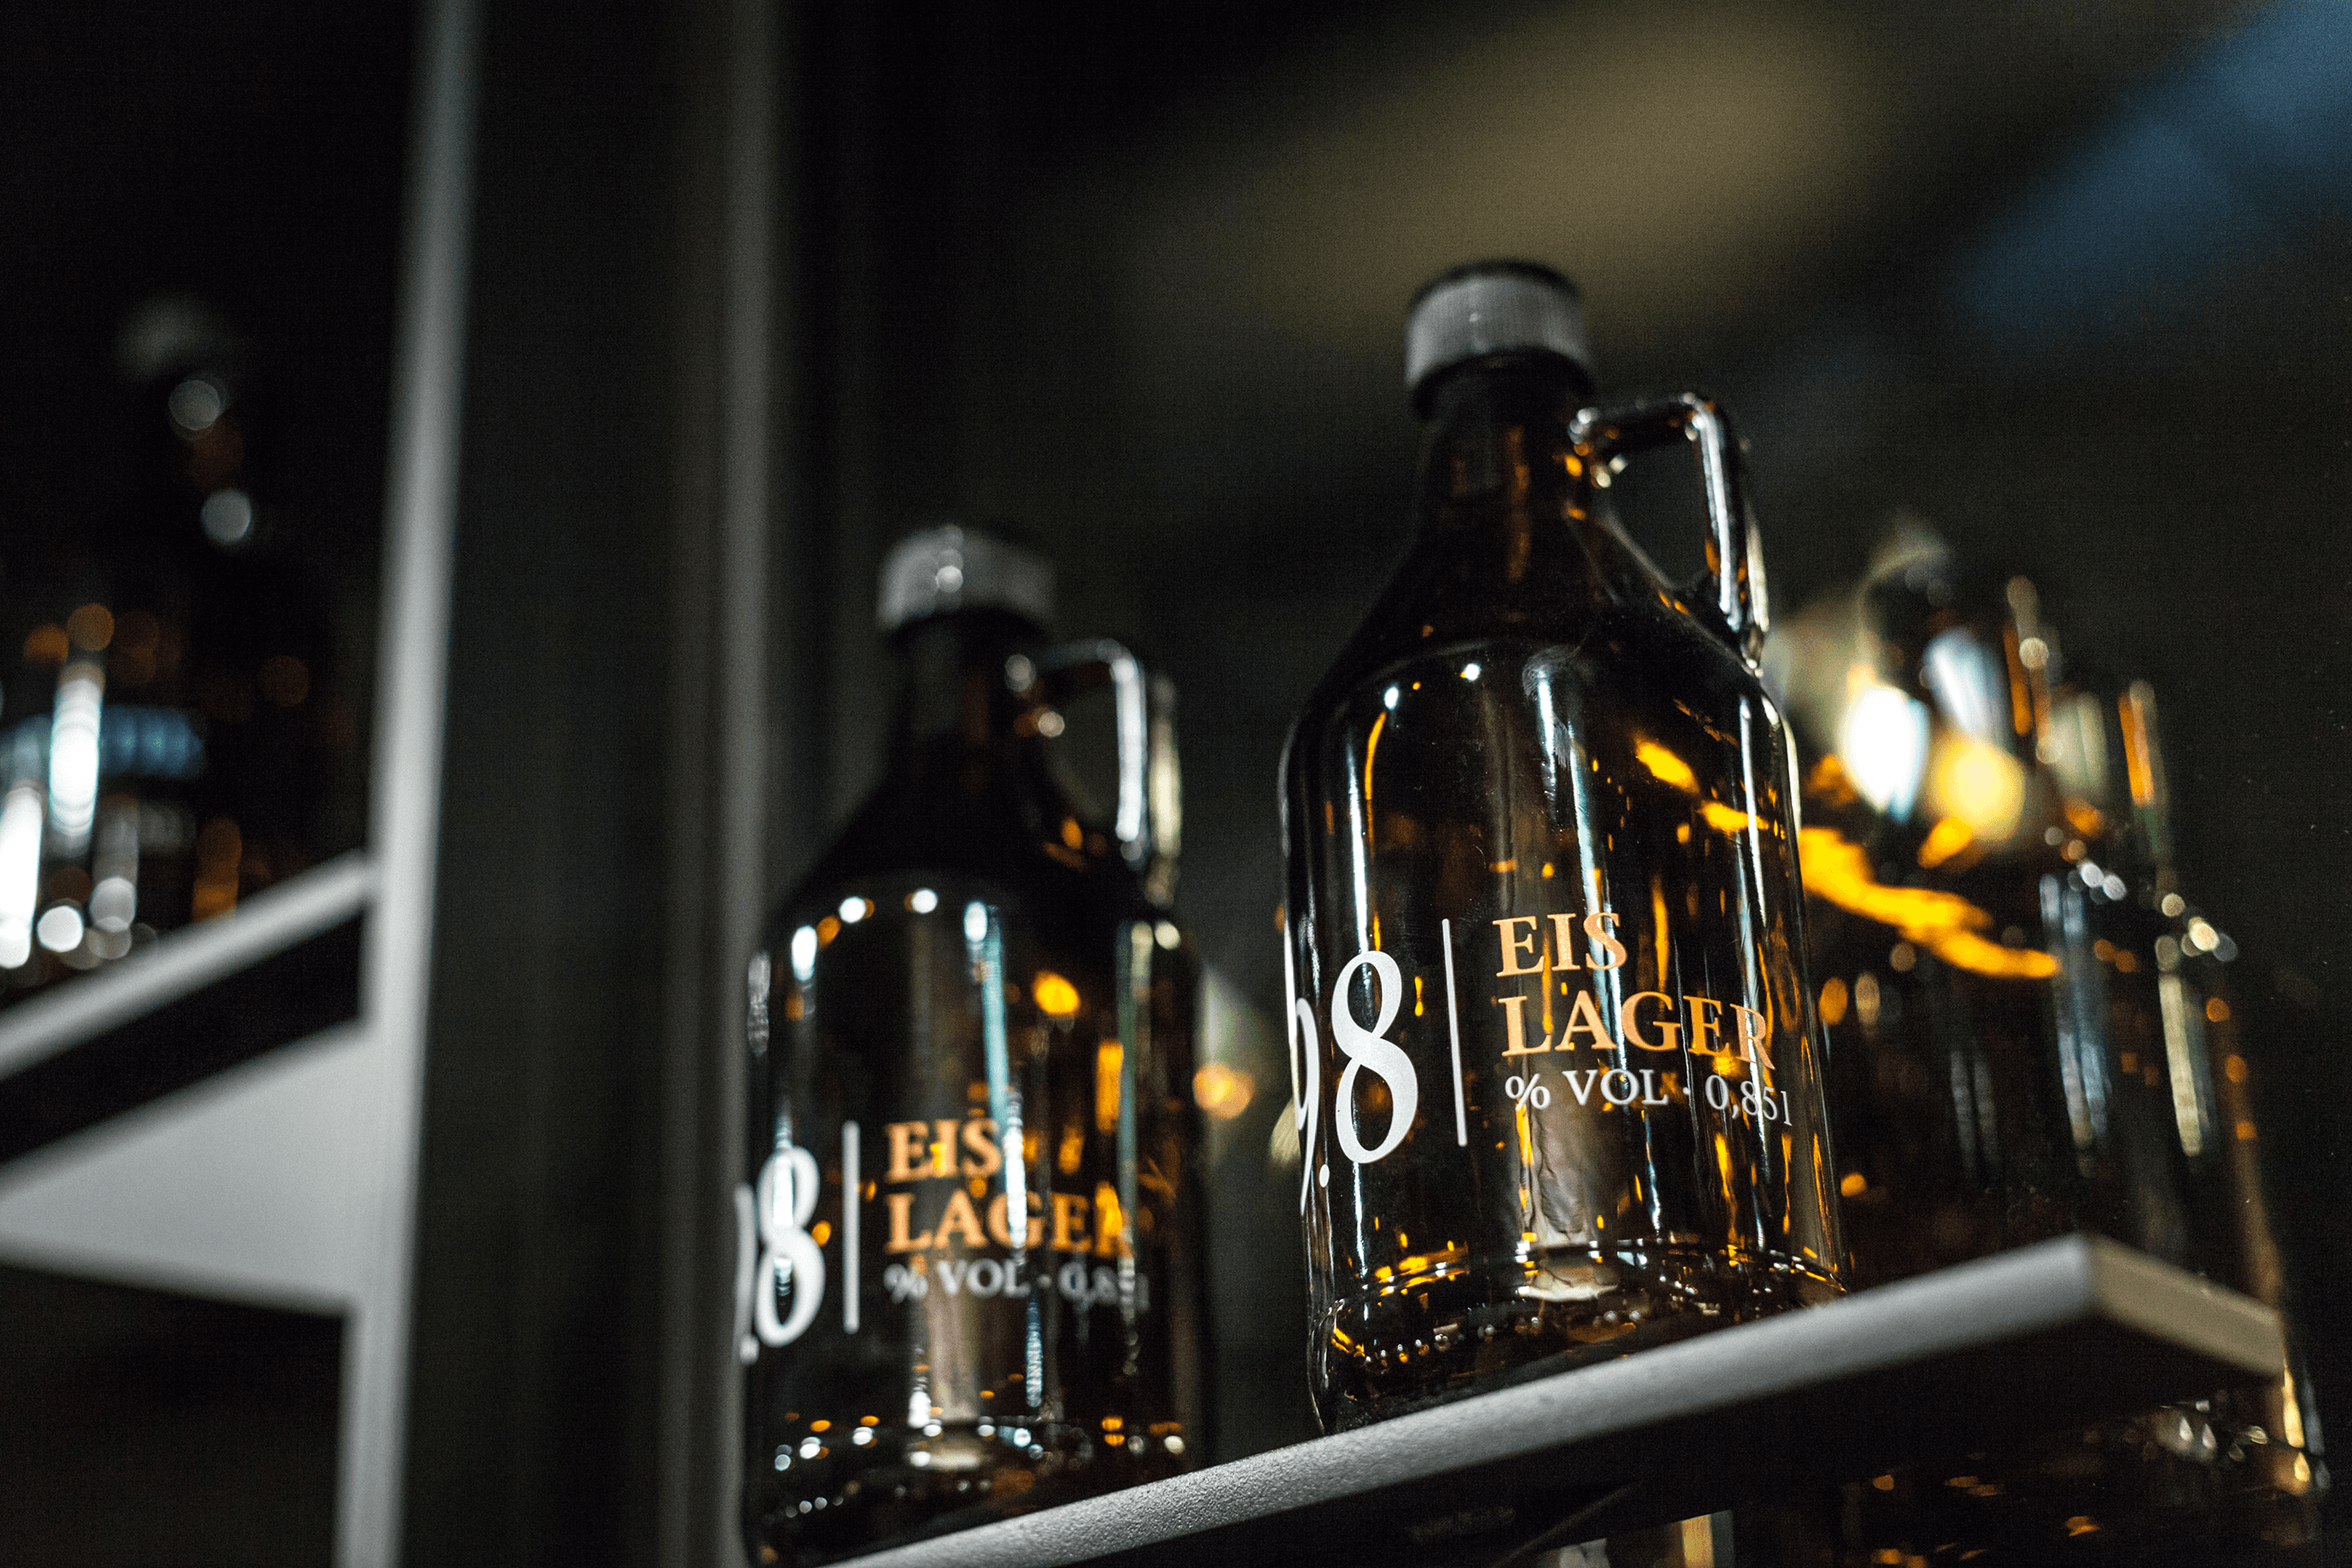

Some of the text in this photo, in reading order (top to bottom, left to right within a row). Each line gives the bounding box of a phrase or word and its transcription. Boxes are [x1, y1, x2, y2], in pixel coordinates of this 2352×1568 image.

[1493, 912, 1628, 978] EIS
[1498, 989, 1776, 1069] LAGER
[1504, 1074, 1552, 1112] %
[1562, 1069, 1669, 1107] VOL
[885, 1119, 1001, 1183] EIS
[935, 1258, 1032, 1298] VOL
